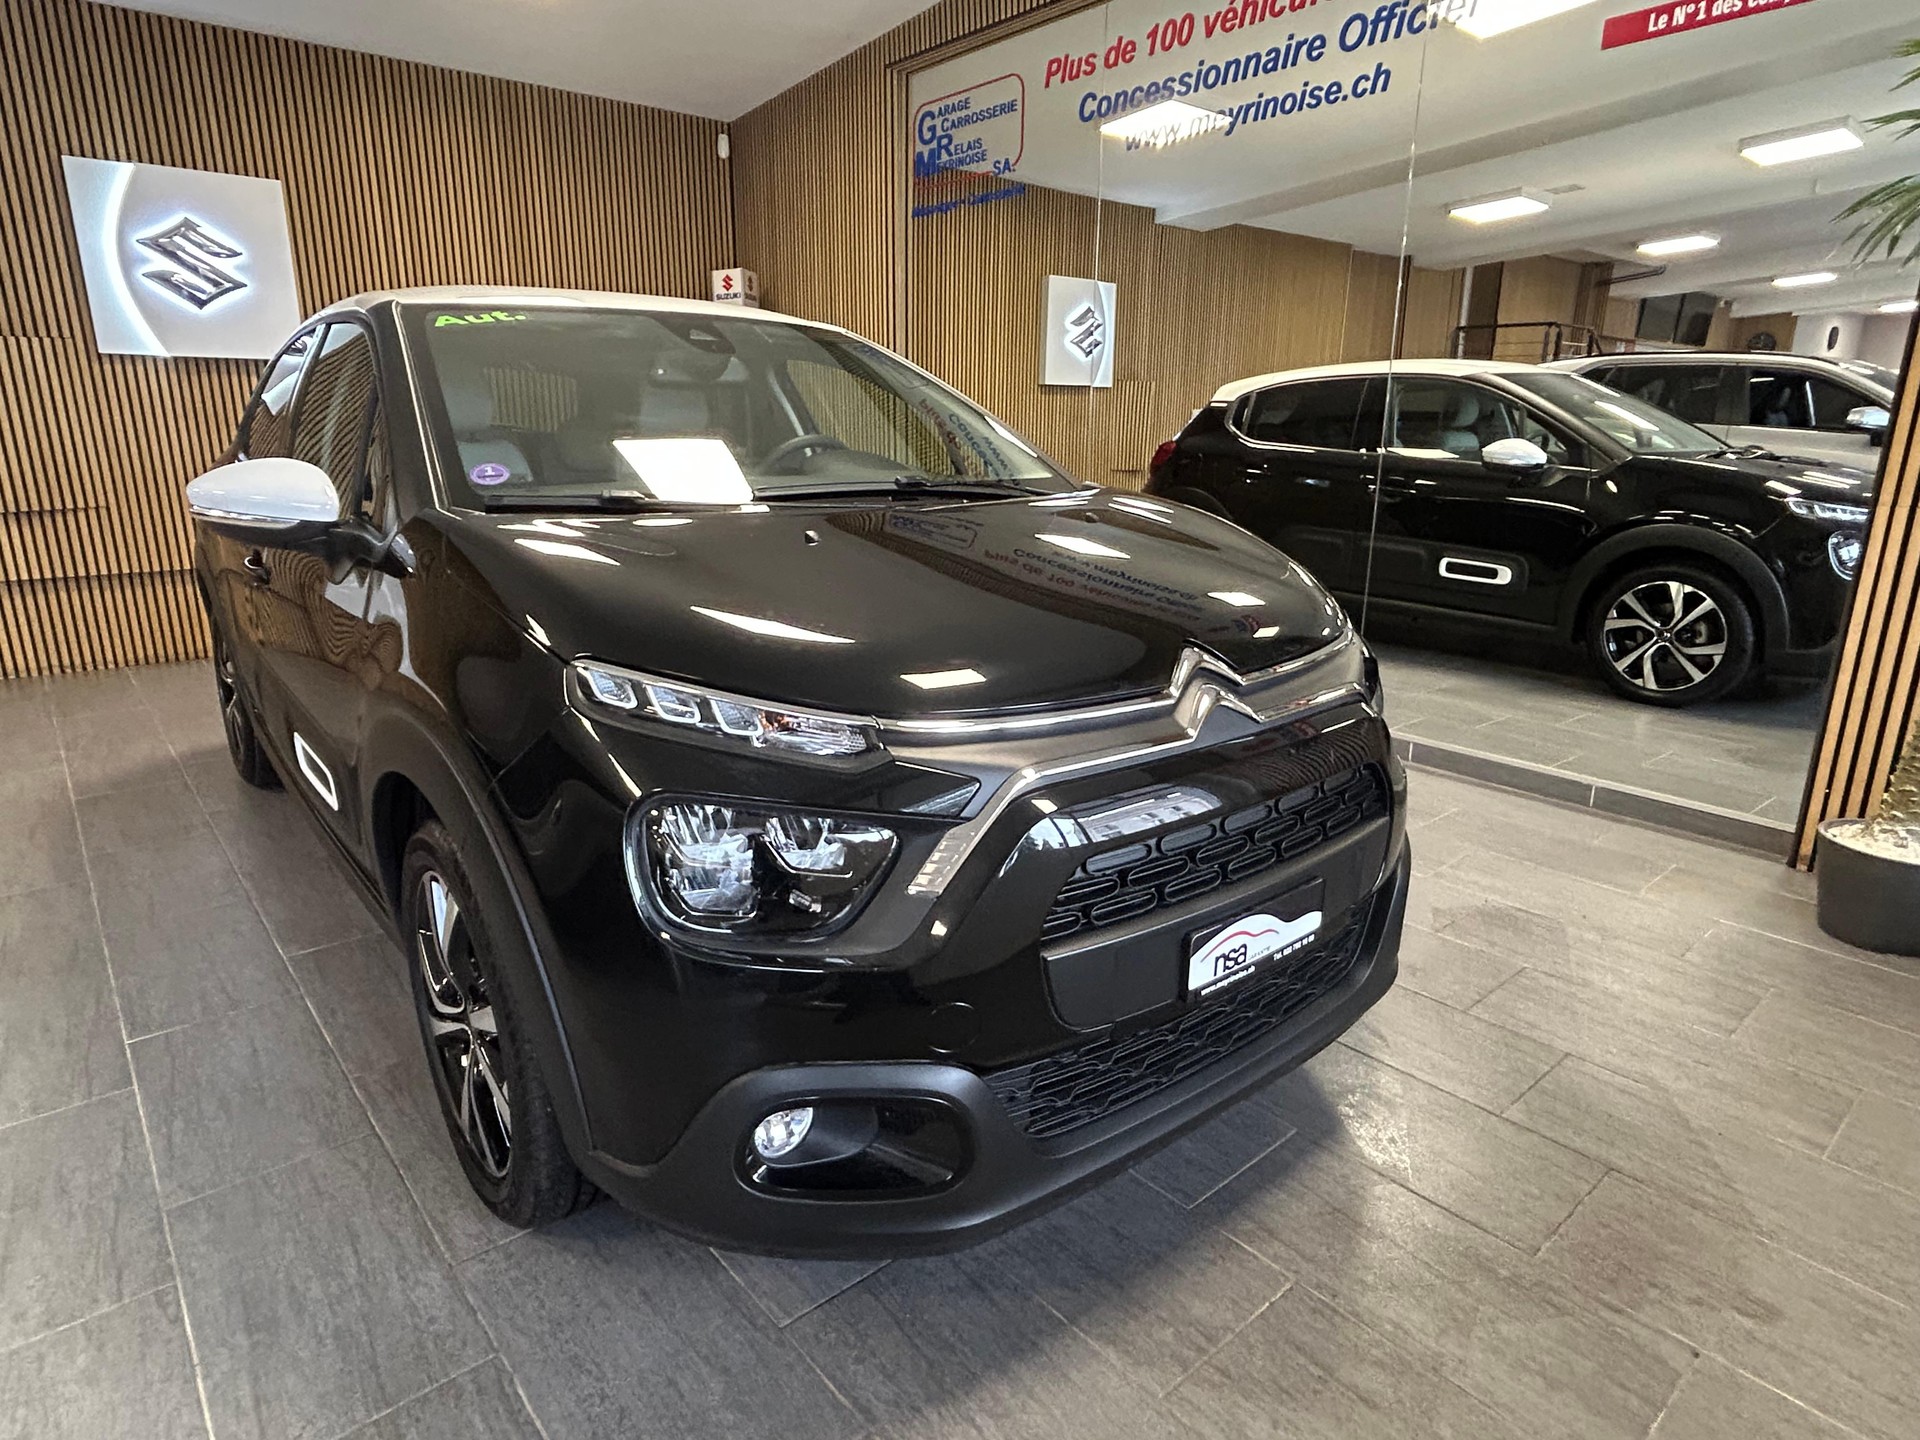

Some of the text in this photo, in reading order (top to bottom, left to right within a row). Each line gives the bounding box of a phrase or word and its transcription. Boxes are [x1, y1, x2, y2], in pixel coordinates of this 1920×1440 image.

[1648, 12, 1669, 33] Le
[1672, 3, 1707, 27] N°1
[1044, 0, 1332, 89] Plus de 100 véhicu
[1079, 33, 1327, 123] Concessionnaire
[941, 99, 1018, 133] CARROSSERIE
[936, 133, 983, 161] RELAIS
[716, 292, 741, 300] SUZUKI
[434, 311, 527, 327] Aut.
[1213, 943, 1247, 977] nsa
